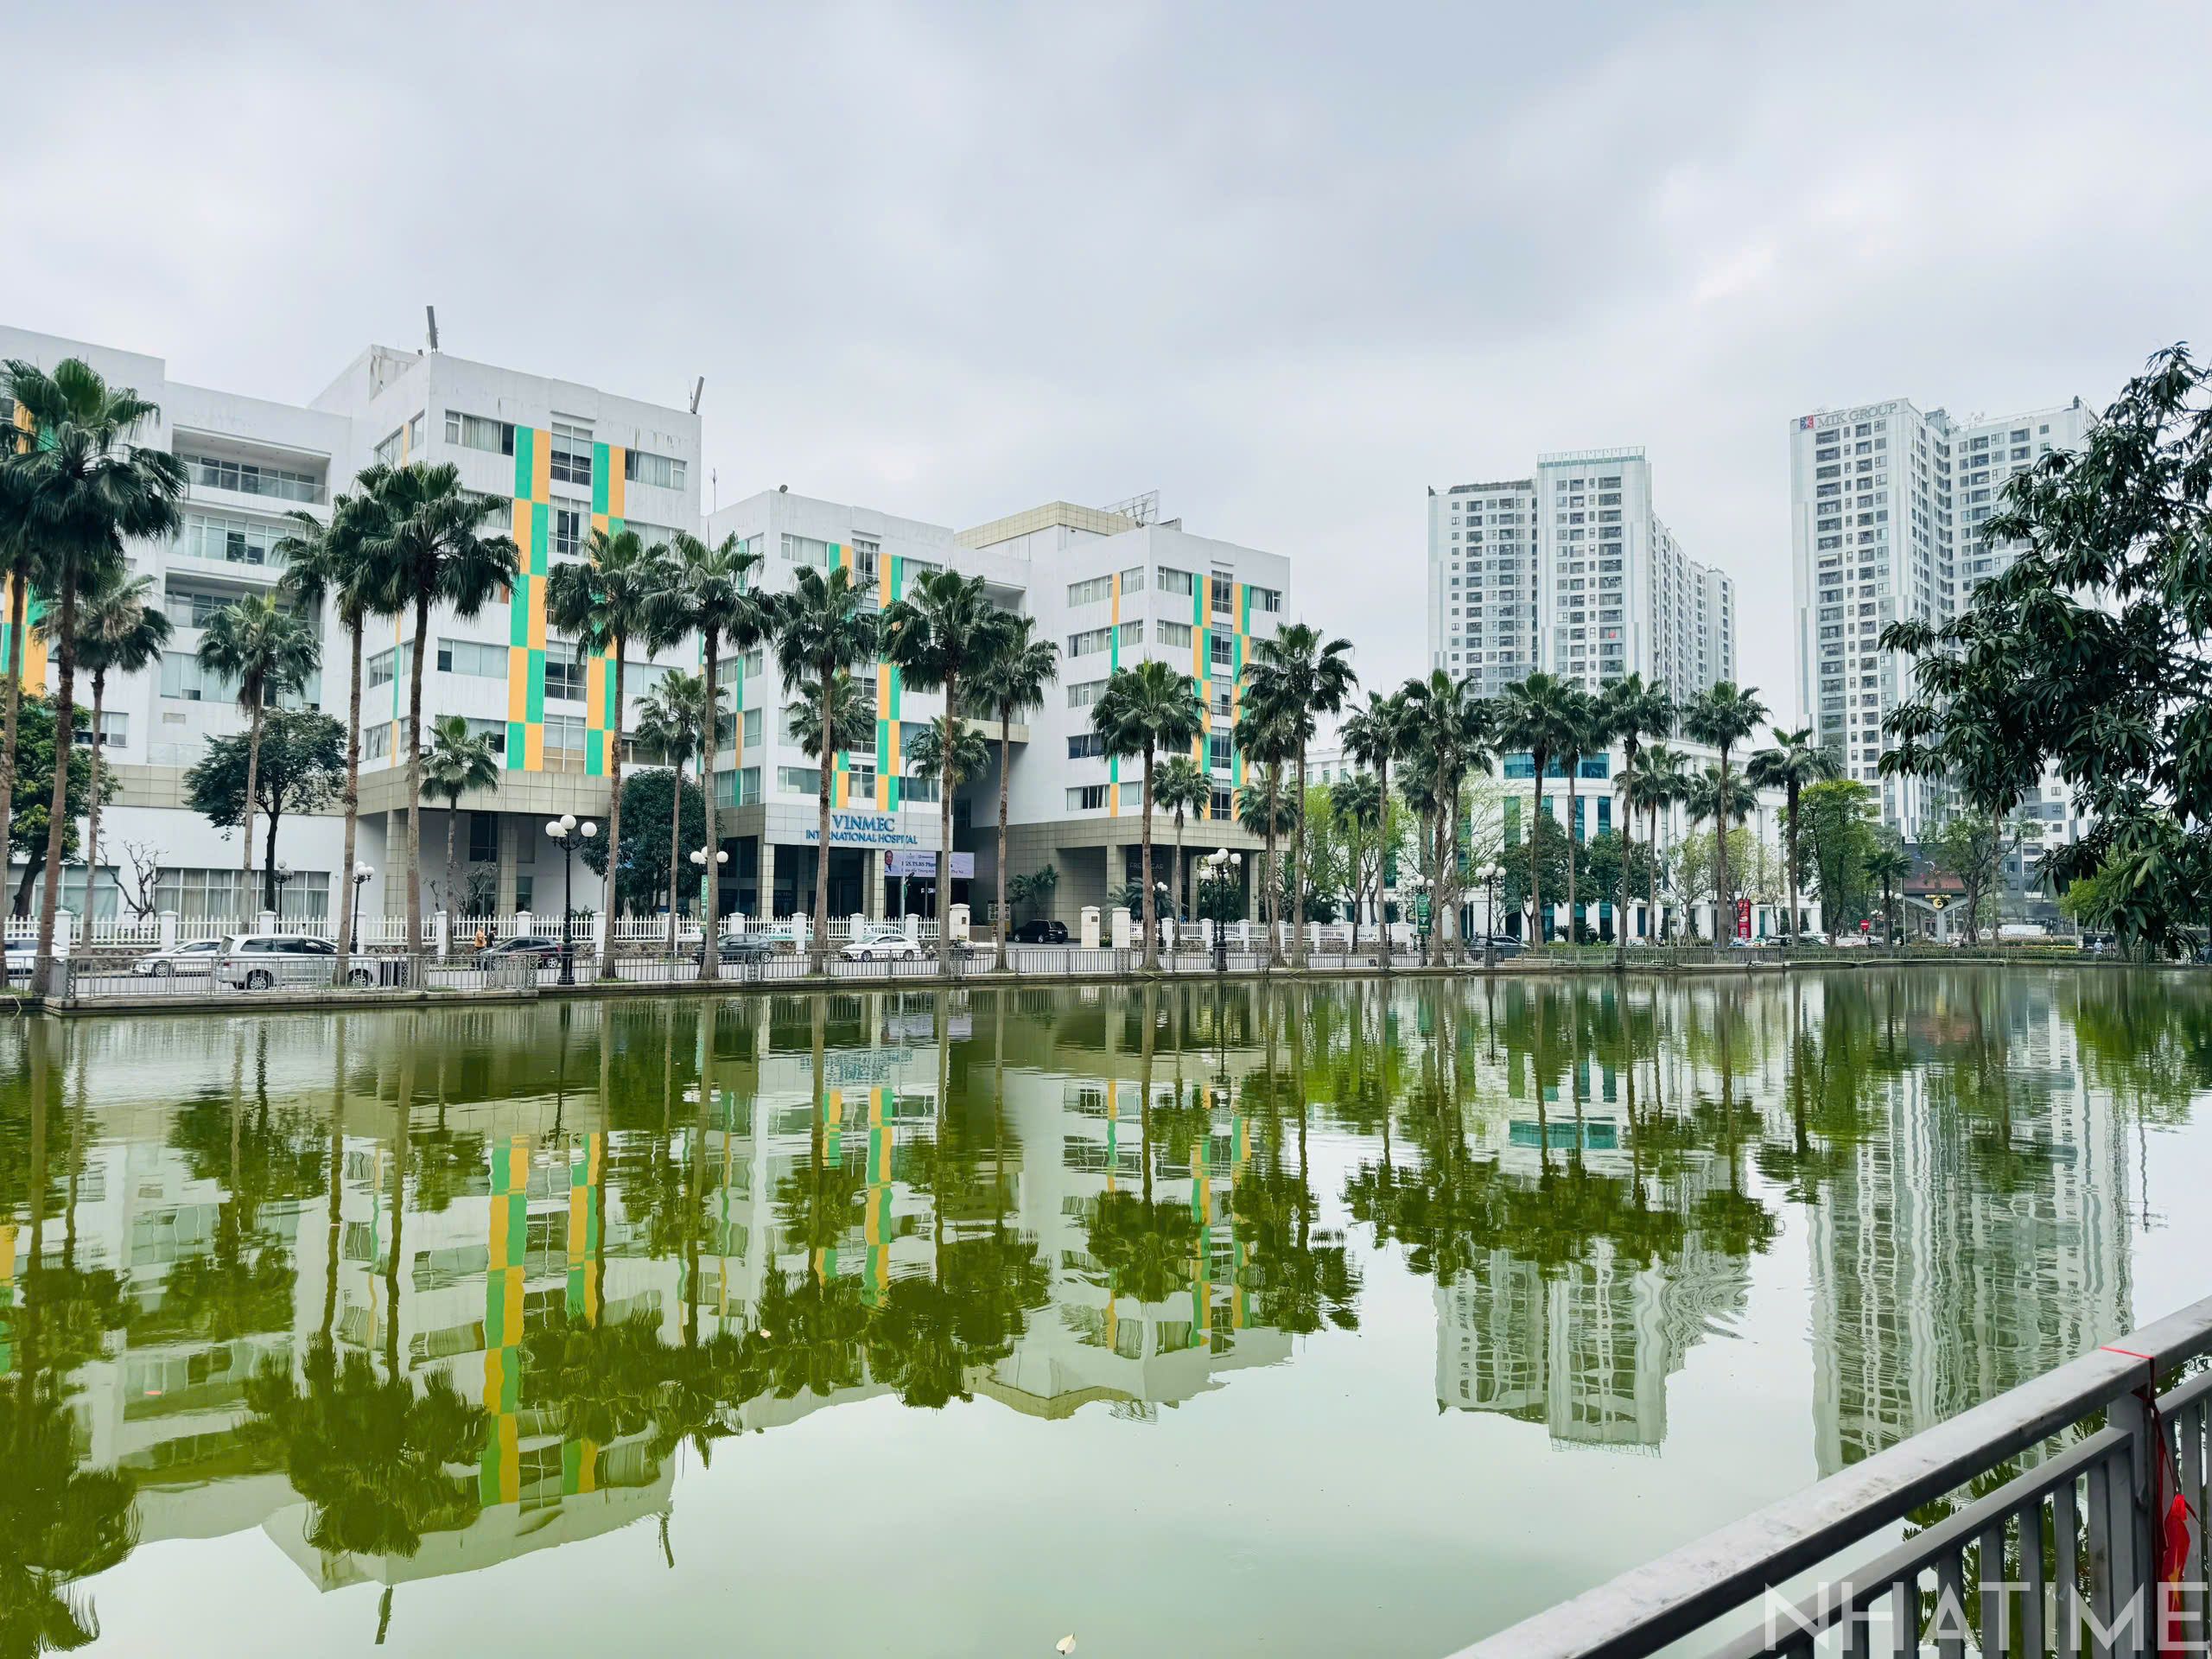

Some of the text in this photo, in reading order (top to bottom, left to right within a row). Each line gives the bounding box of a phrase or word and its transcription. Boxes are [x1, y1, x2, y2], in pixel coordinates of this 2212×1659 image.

[1817, 402, 1897, 428] MIK GROUP
[831, 815, 895, 832] VINMEC
